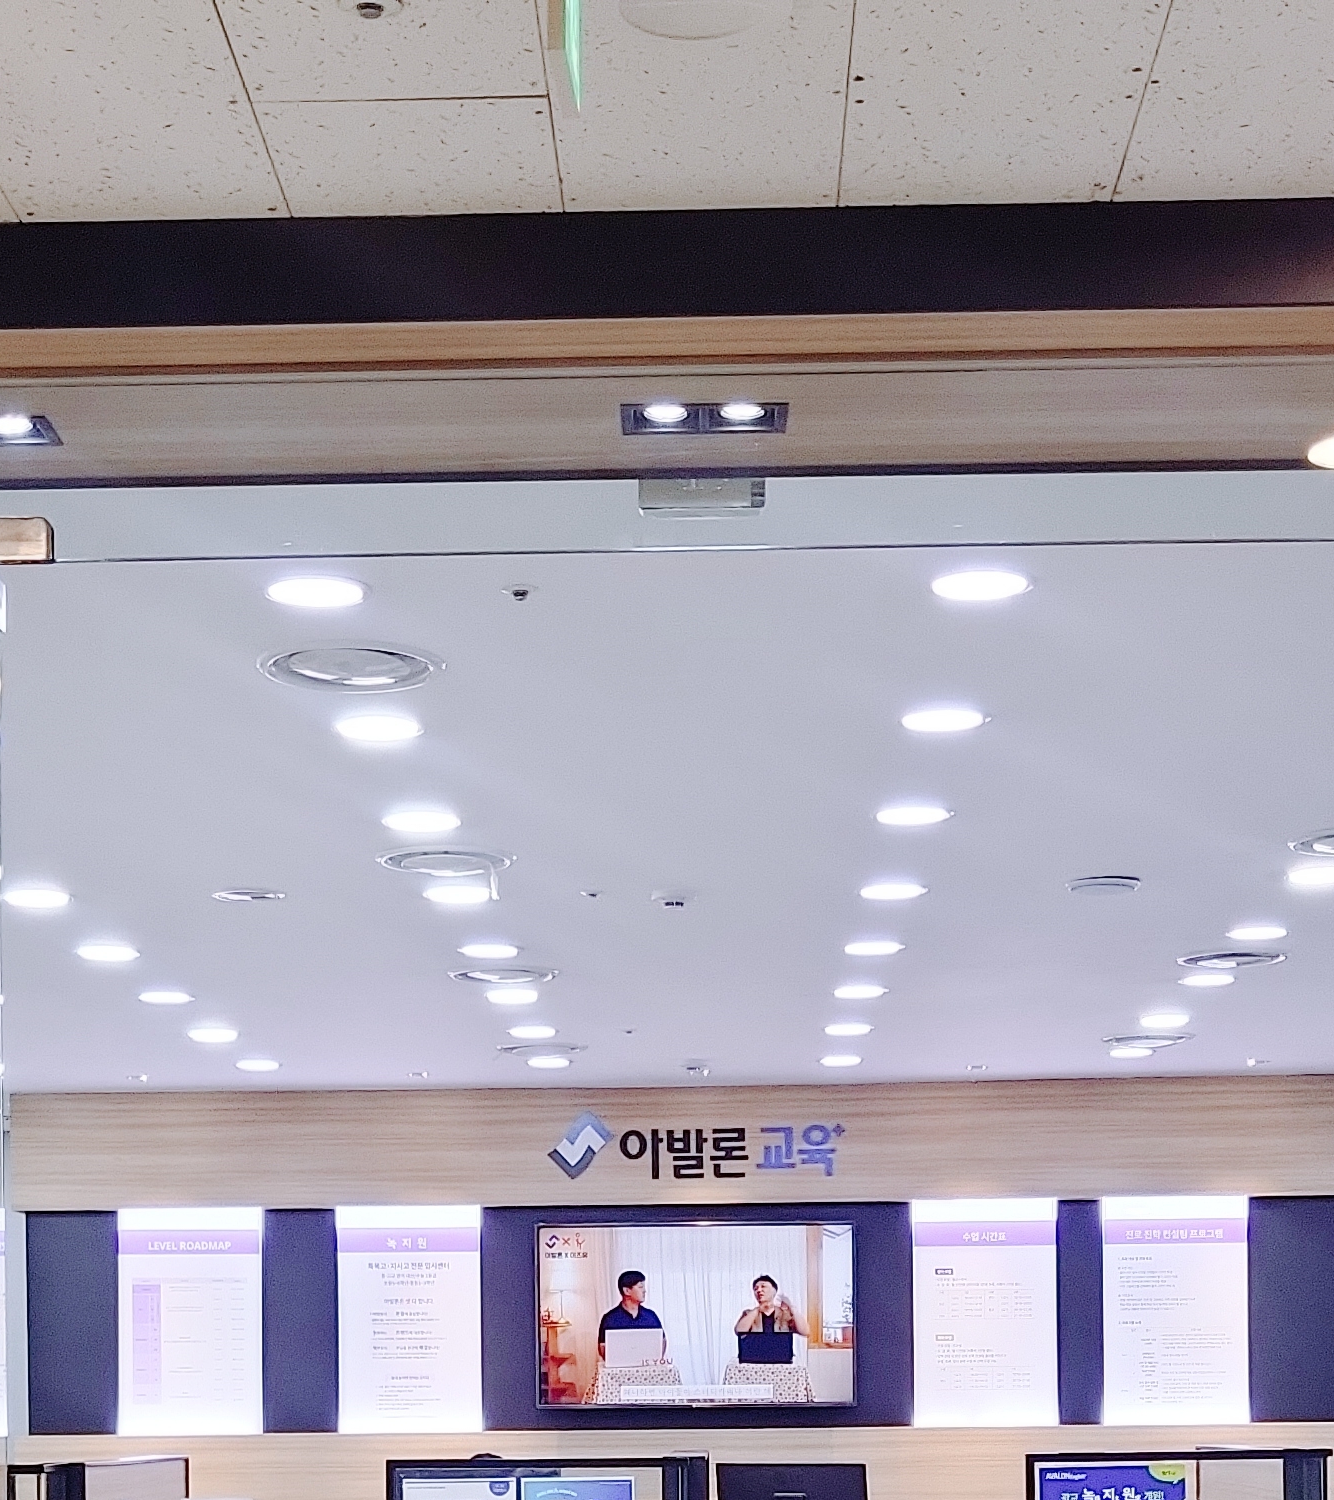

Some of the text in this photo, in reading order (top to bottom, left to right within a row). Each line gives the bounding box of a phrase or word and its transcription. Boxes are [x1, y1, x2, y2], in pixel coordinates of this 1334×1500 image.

[619, 1127, 749, 1180] 아발론
[148, 1240, 232, 1251] LEVEL ROADMAP
